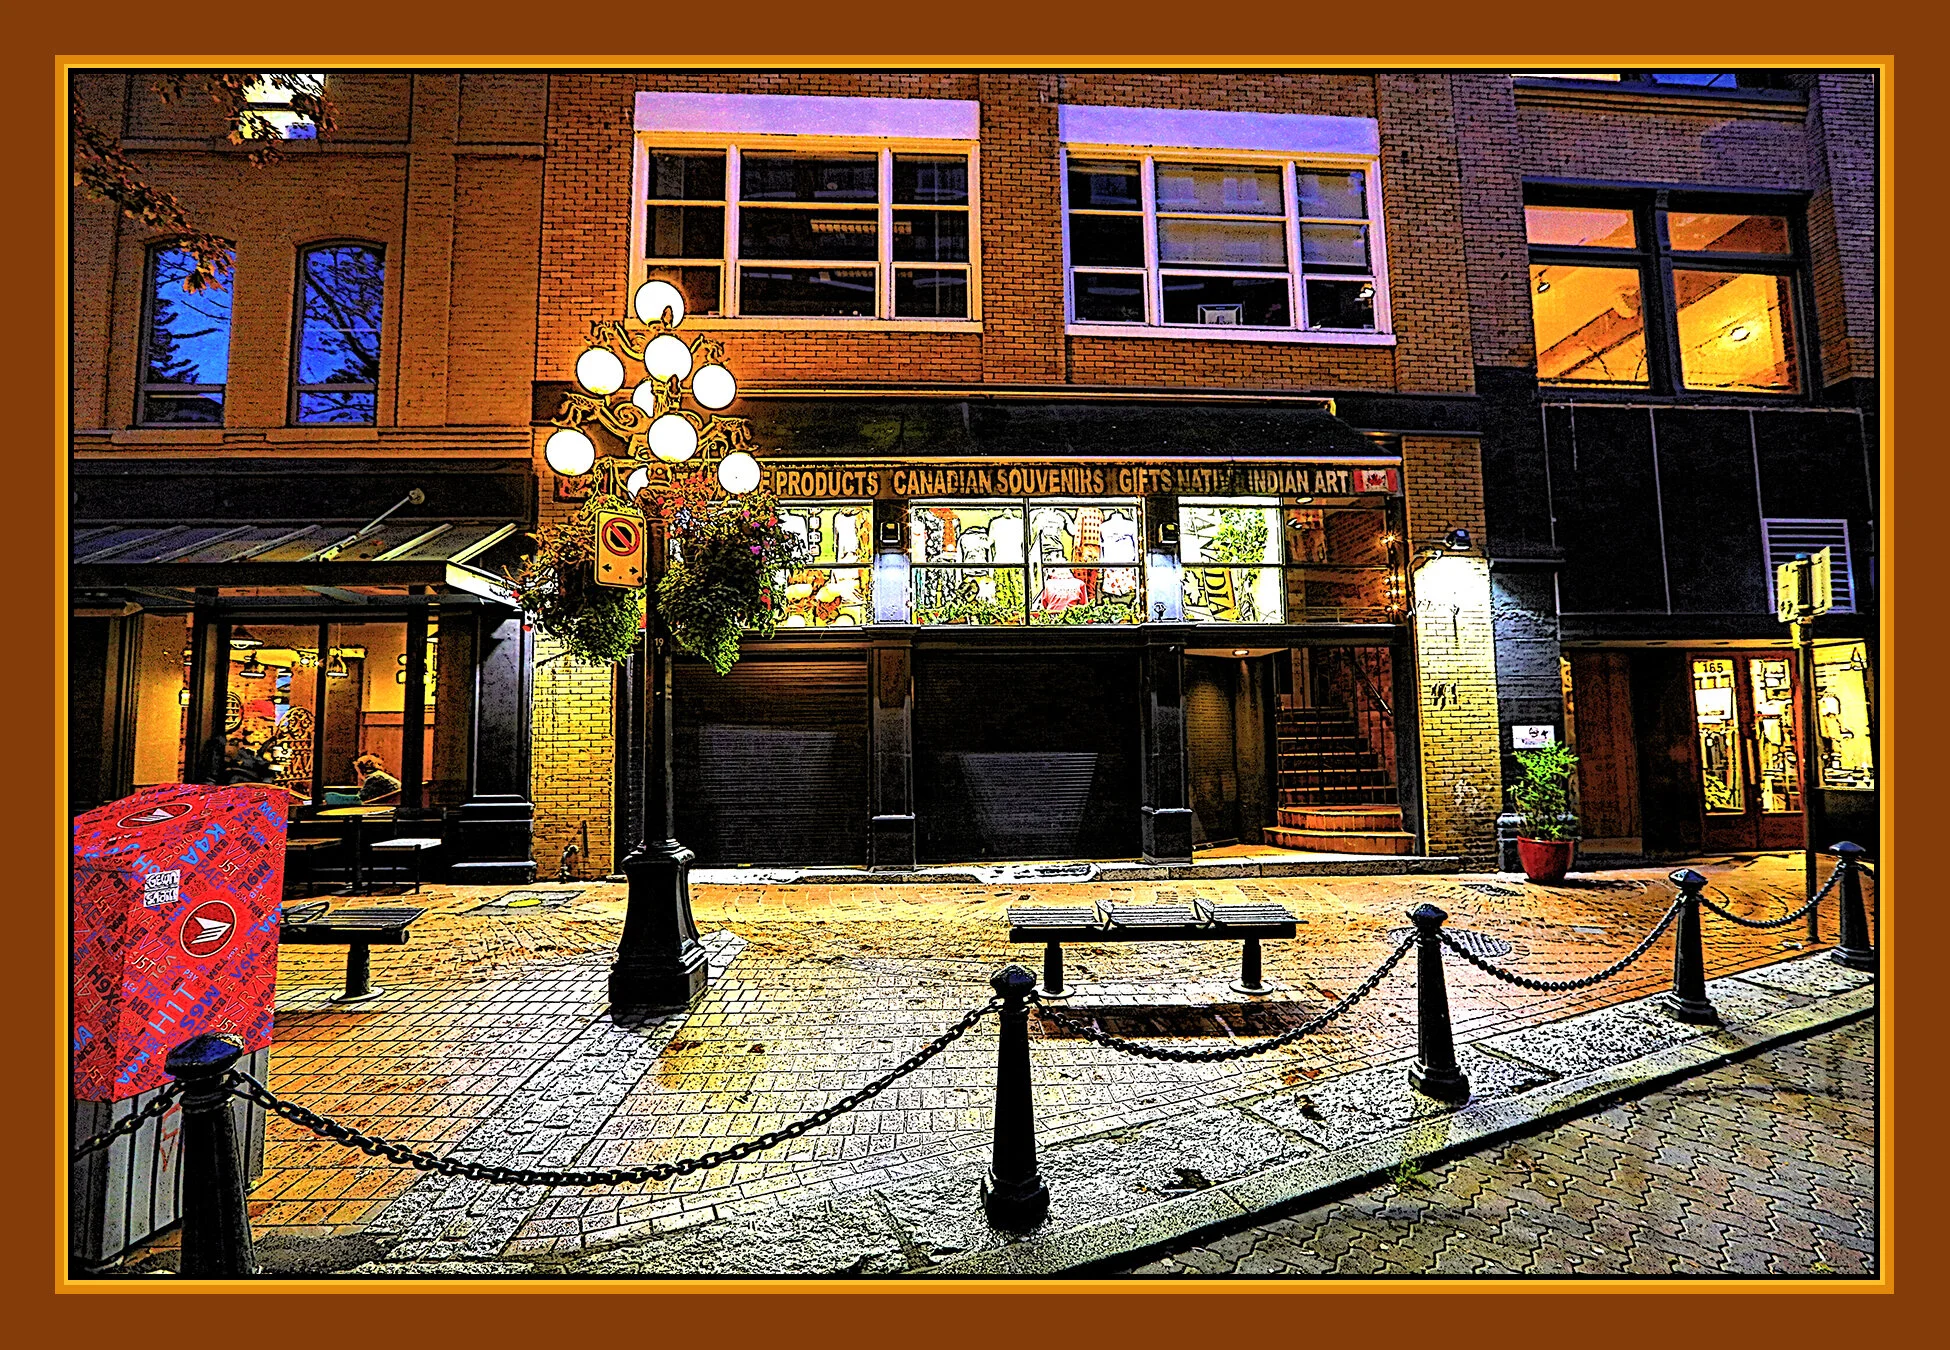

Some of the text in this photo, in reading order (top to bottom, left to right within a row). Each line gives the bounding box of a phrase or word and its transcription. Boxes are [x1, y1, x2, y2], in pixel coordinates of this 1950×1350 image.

[776, 470, 879, 496] PRODUCTS
[893, 470, 993, 495] CANADIAN
[997, 468, 1105, 494] SOUVENIRS
[1120, 468, 1172, 494] GIFTS
[1315, 470, 1348, 494] ART
[1703, 662, 1724, 674] 165
[258, 801, 283, 828] M6S
[179, 822, 227, 866] K4A
[205, 839, 229, 861] E3N
[226, 840, 252, 868] V7J
[235, 832, 260, 855] J6W
[218, 859, 240, 877] J5T
[238, 860, 271, 891] M9L
[127, 904, 154, 925] X1A
[139, 933, 170, 962] V7J
[131, 954, 156, 973] J5T
[183, 968, 199, 982] P3Y
[206, 958, 229, 980] T3M
[229, 948, 259, 979] V6K
[87, 964, 120, 1008] H9X
[148, 981, 195, 1034] H1T
[179, 985, 221, 1031] M6S
[204, 997, 227, 1022] E3N
[224, 997, 250, 1023] V7J
[216, 1017, 238, 1035] J5T
[116, 1051, 151, 1085] K4A
